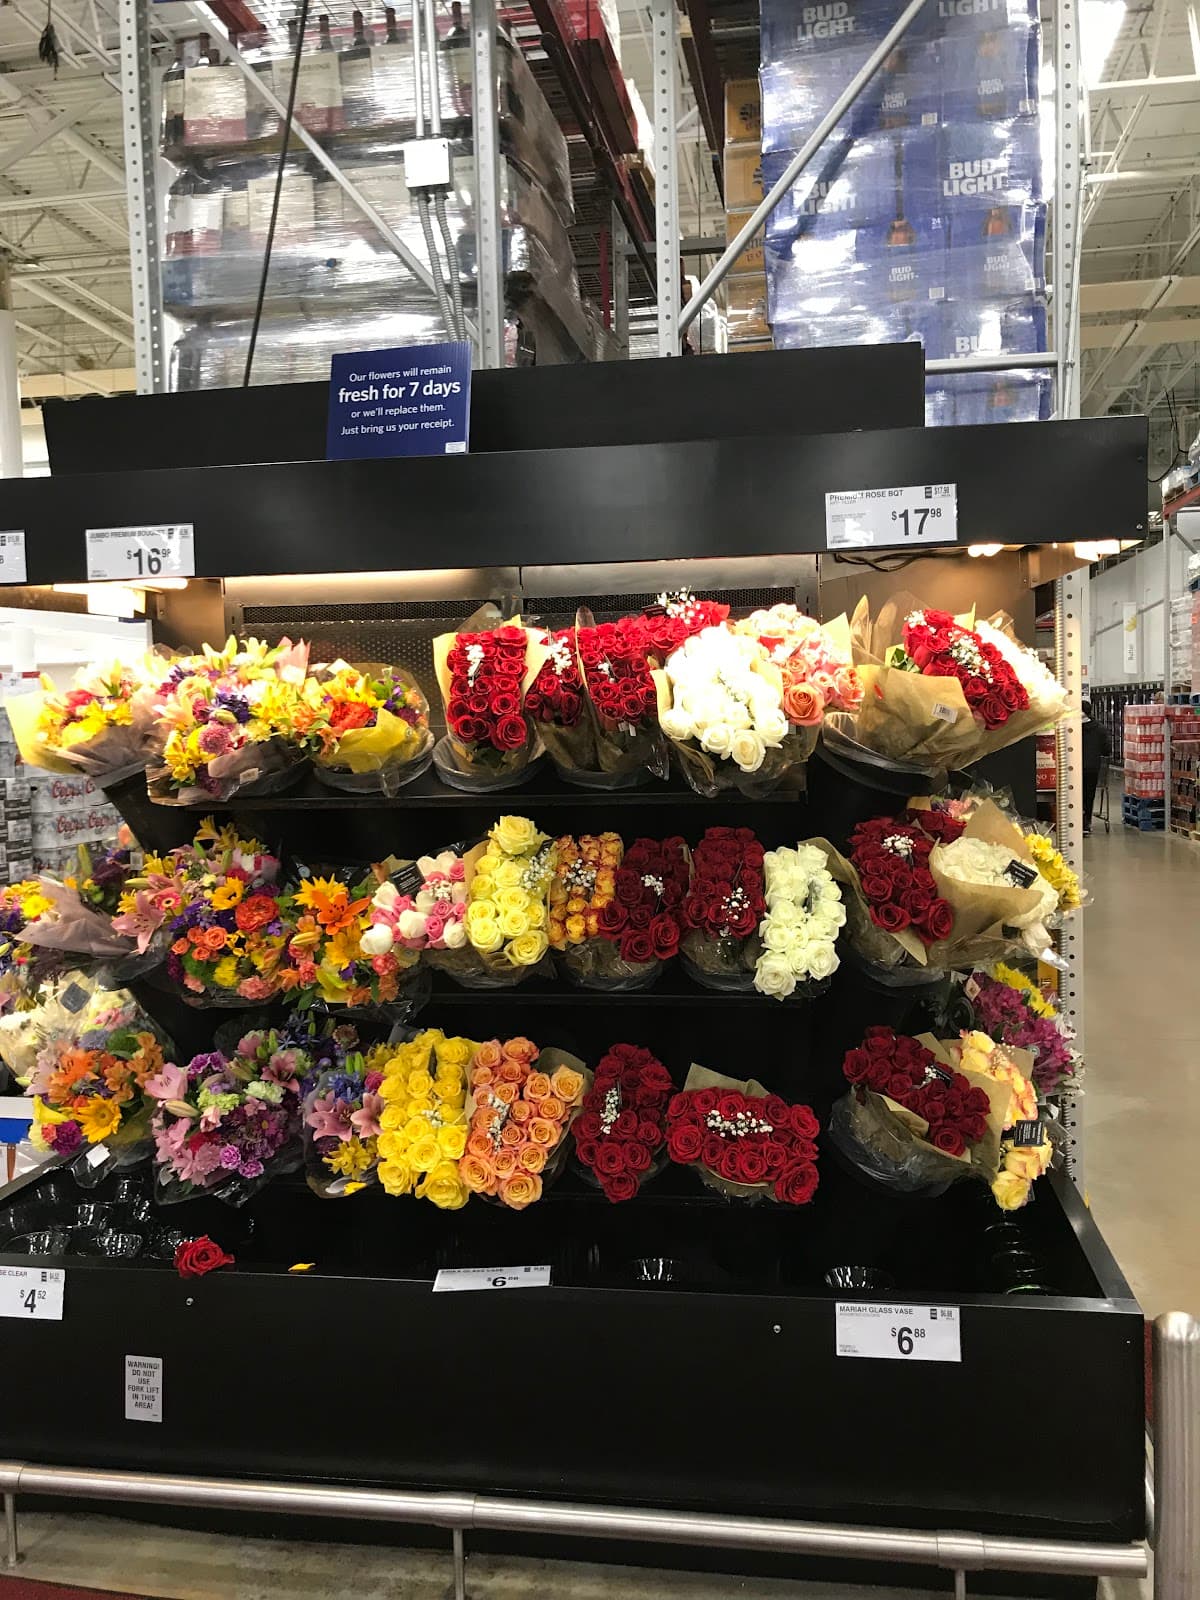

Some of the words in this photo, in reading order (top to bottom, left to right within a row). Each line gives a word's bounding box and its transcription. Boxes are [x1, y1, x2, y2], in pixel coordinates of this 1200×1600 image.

[803, 2, 849, 23] BUD
[797, 16, 855, 41] LIGHT
[950, 158, 998, 179] BUD
[943, 172, 1007, 197] LIGHT
[891, 265, 912, 275] BUD
[889, 271, 916, 282] LIGHT
[349, 373, 367, 382] Our
[368, 371, 401, 381] flowers
[403, 367, 418, 377] will
[420, 365, 452, 376] remain
[338, 385, 379, 403] fresh
[382, 384, 406, 400] for
[409, 382, 420, 397] 7
[423, 380, 461, 398] days
[351, 411, 361, 419] or
[363, 407, 383, 417] we'll
[385, 405, 418, 417] replace
[420, 403, 446, 413] them.
[340, 426, 359, 436] Just
[361, 425, 384, 435] bring
[386, 424, 397, 432] us
[398, 421, 418, 433] your
[420, 418, 455, 430] receipt.
[866, 490, 887, 499] ROSE
[888, 489, 904, 497] BQT
[8, 1270, 28, 1278] CLEAR
[840, 1306, 867, 1314] MARIAH
[868, 1306, 893, 1314] GLASS
[894, 1307, 914, 1315] VASE
[127, 1360, 160, 1370] WARNING!
[131, 1369, 141, 1377] DO
[142, 1370, 156, 1378] NOT
[127, 1385, 144, 1393] FORK
[146, 1386, 160, 1394] LIFT
[131, 1393, 139, 1401] IN
[141, 1393, 156, 1402] THIS
[134, 1401, 153, 1410] AREA!
